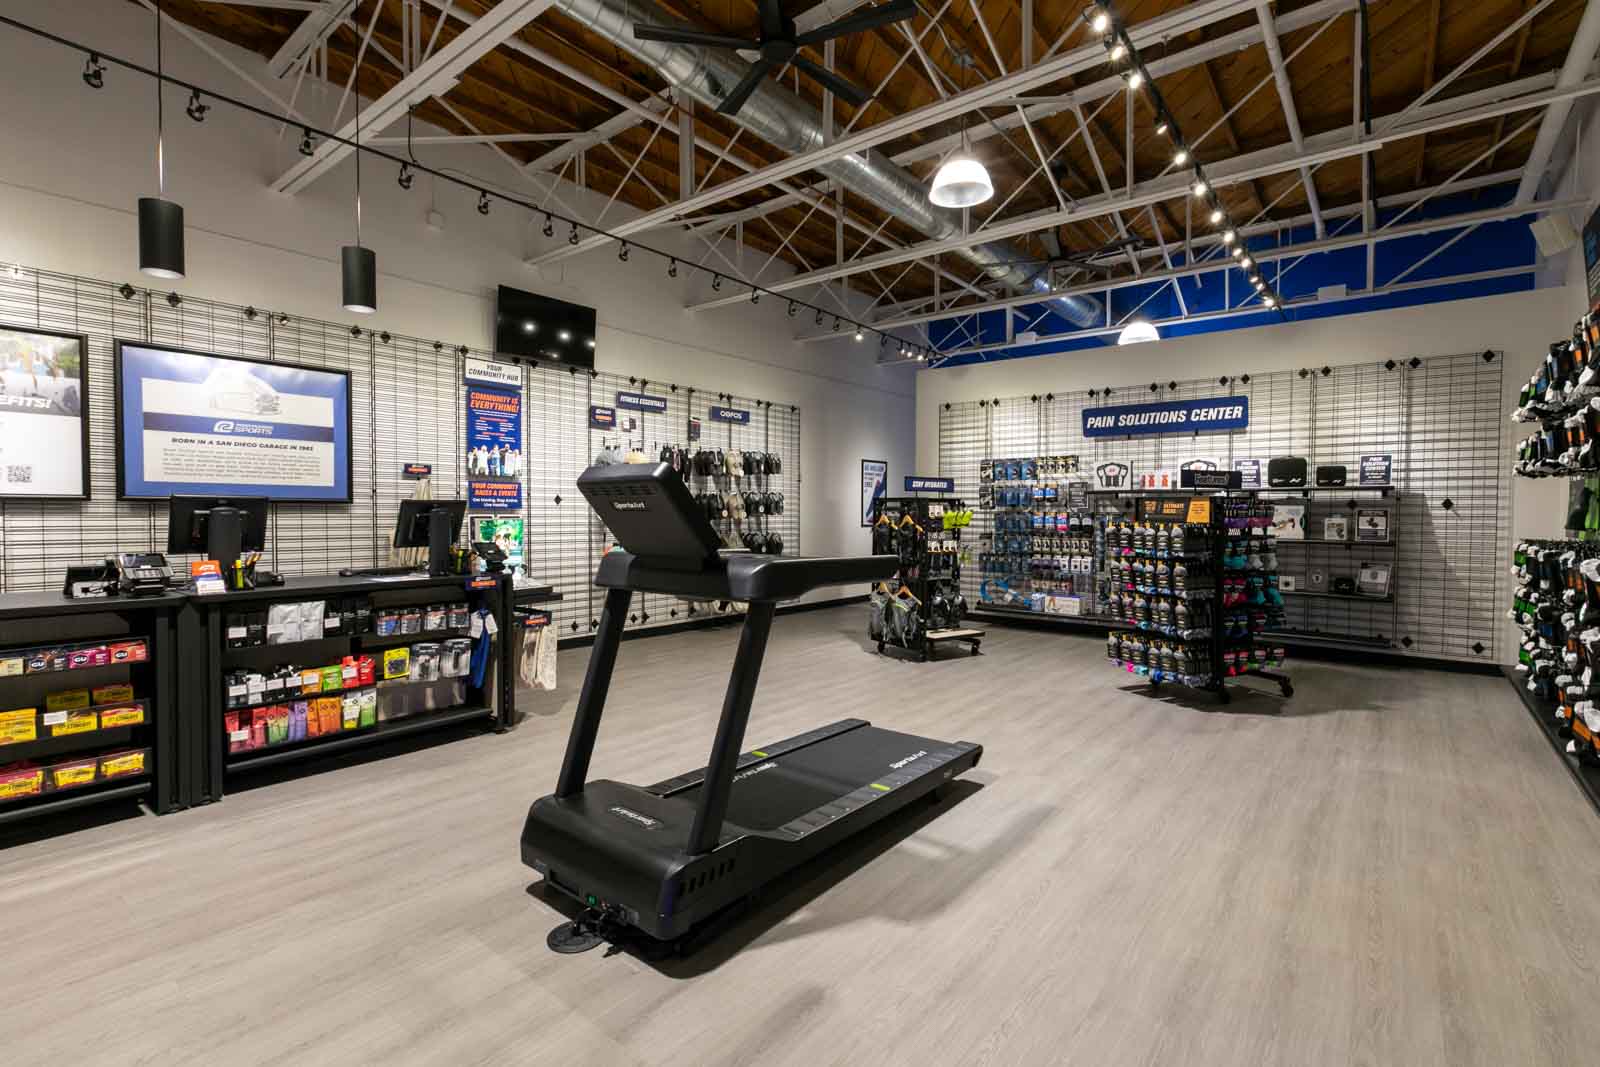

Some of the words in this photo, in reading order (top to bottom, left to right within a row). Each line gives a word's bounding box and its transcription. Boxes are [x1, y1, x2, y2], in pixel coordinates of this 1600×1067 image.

[469, 369, 505, 380] COMMUNITY
[471, 392, 509, 402] COMMUNITY
[471, 399, 519, 413] EVERYTHING!
[1086, 415, 1115, 429] PAIN
[1118, 410, 1187, 427] SOLUTIONS
[1190, 405, 1243, 422] CENTER
